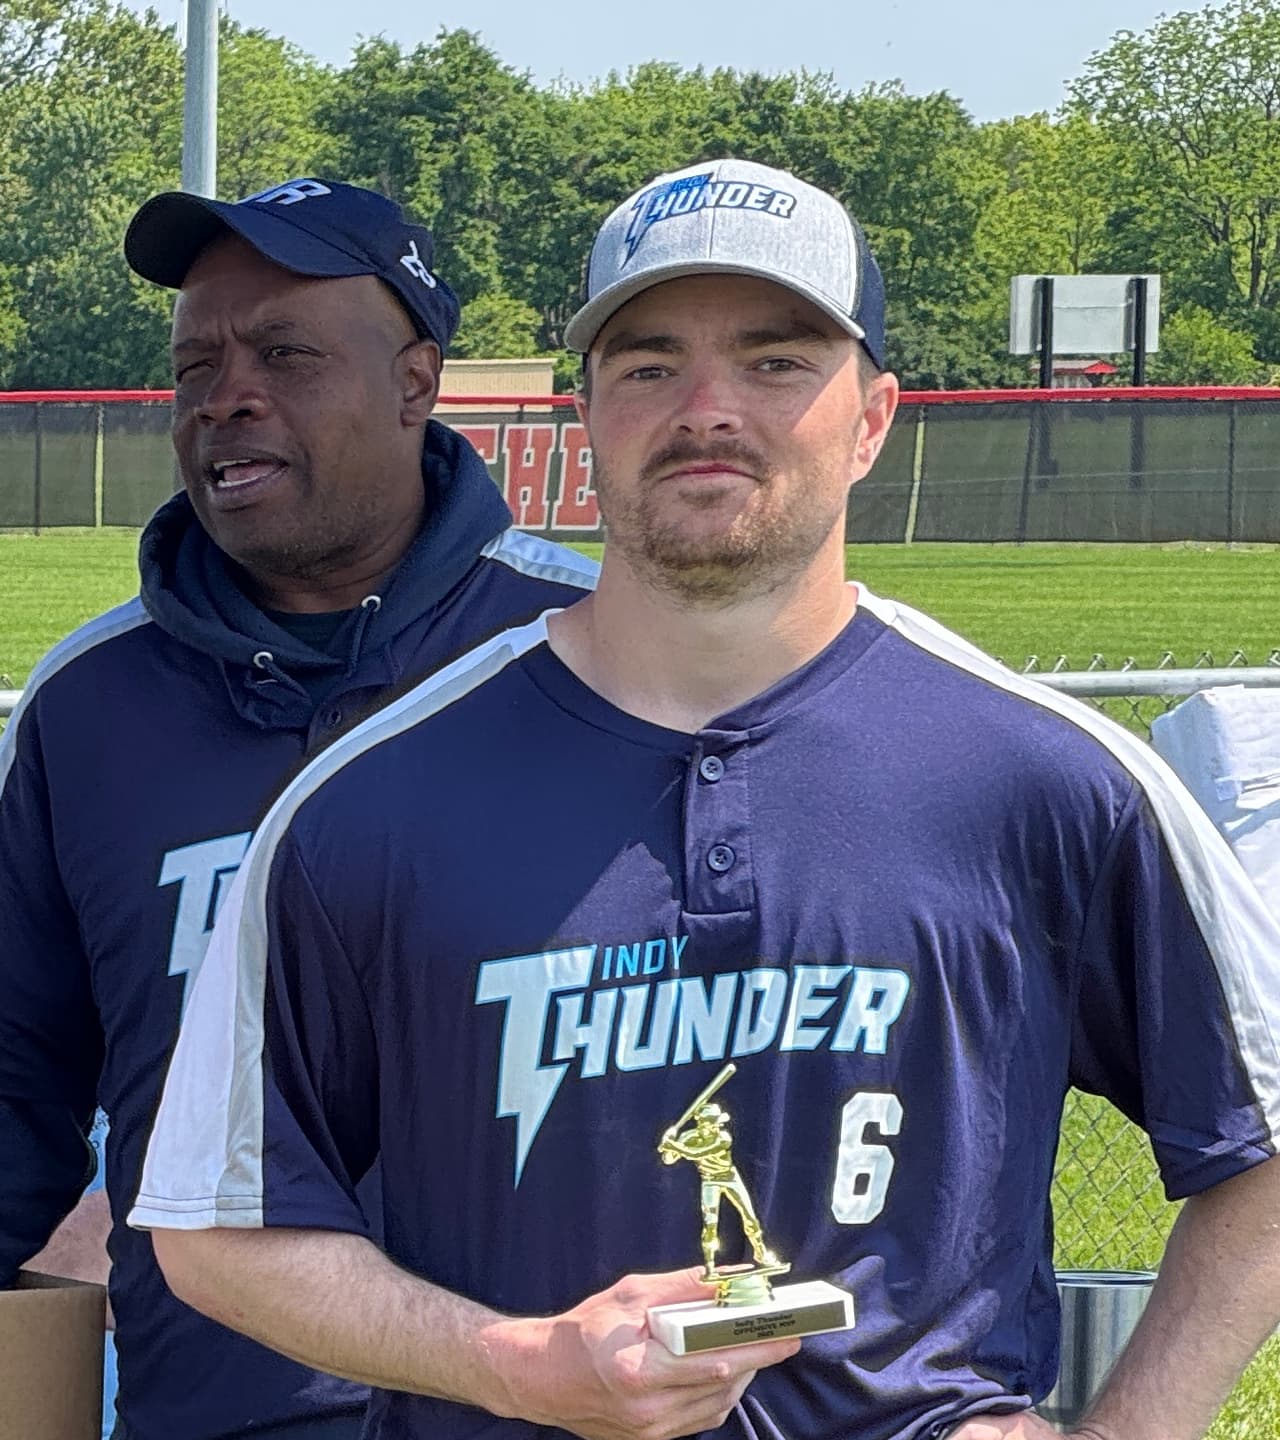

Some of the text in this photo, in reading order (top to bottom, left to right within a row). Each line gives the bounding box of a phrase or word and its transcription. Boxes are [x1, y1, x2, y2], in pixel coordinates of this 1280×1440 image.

[621, 181, 797, 270] THUNDER
[601, 935, 689, 981] INDY
[474, 944, 910, 1191] THUNDER
[830, 1091, 904, 1225] 6
